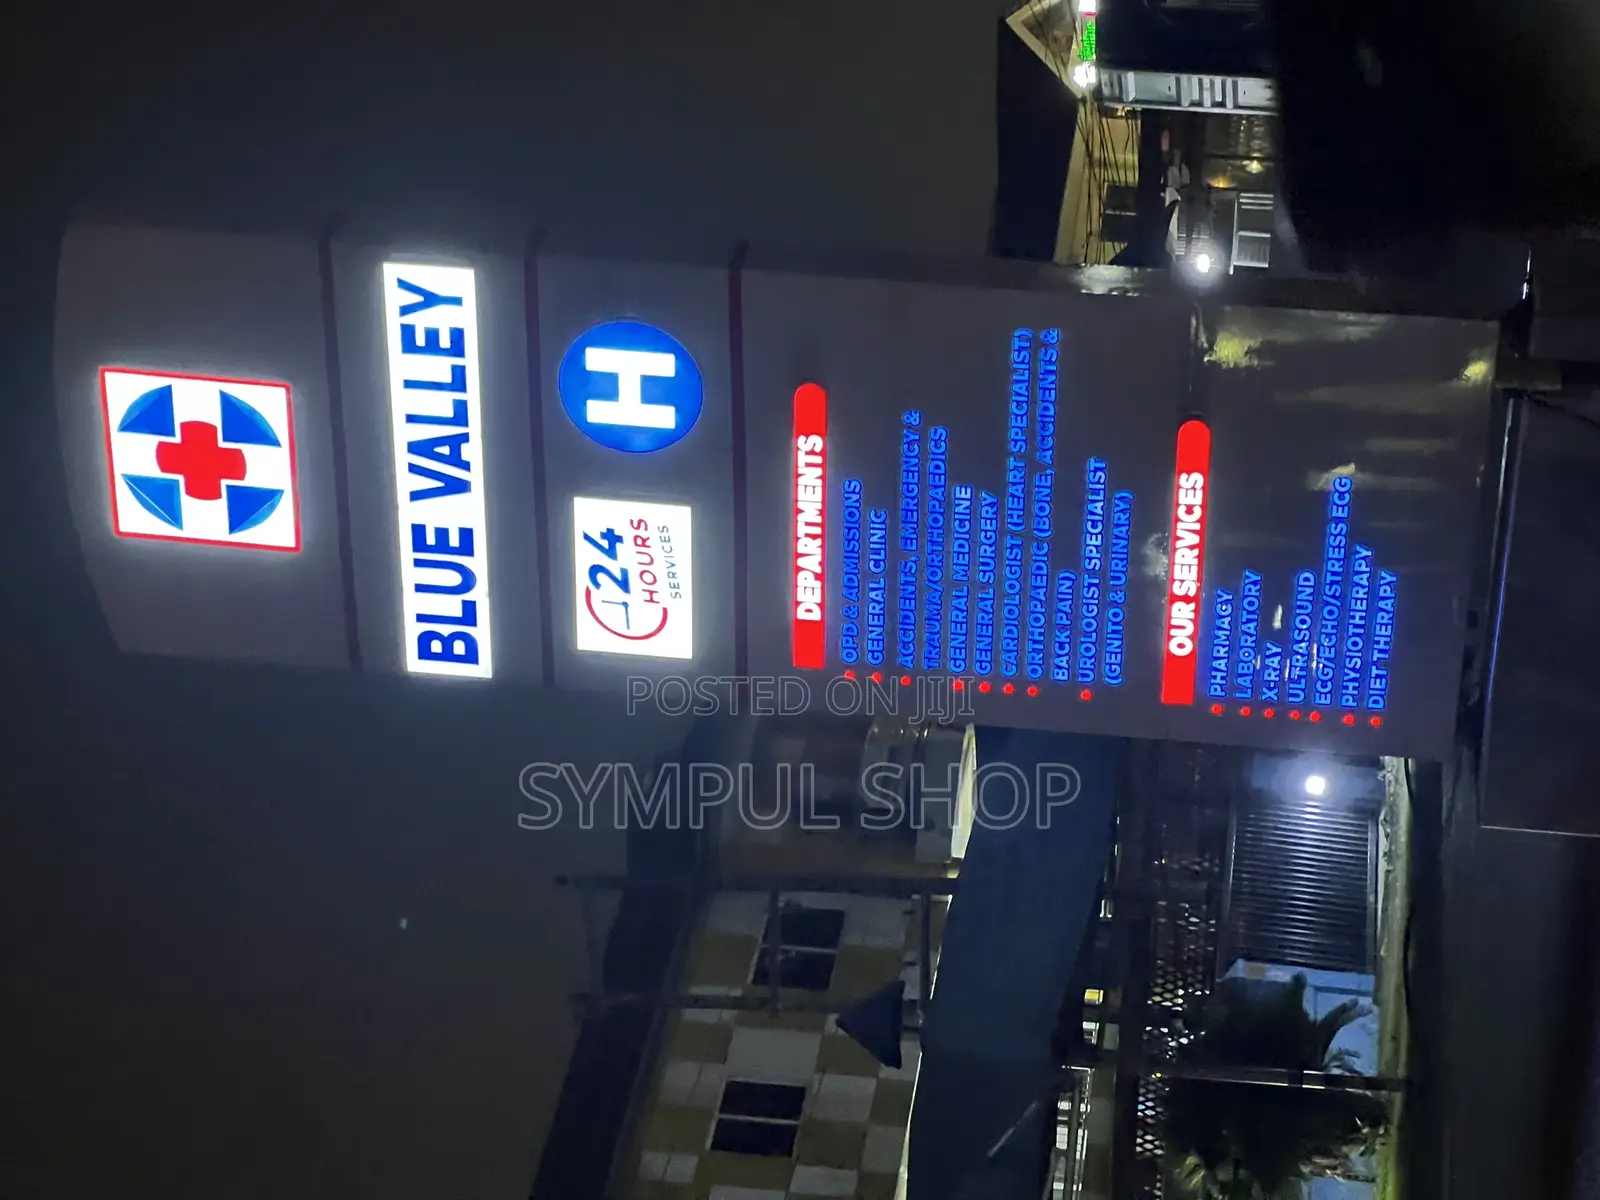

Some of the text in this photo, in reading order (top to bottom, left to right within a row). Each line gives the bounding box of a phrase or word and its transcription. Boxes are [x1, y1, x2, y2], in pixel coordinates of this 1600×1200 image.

[396, 277, 479, 665] BLUE VALLEY
[584, 348, 676, 430] H
[583, 528, 629, 595] 24
[630, 518, 659, 604] HOURS
[658, 525, 681, 600] SERVICES
[797, 435, 823, 621] DEPARTMENTS
[842, 479, 861, 663] OPD & ADMISSIONS
[868, 509, 887, 665] GENERAL CLINIC
[899, 410, 920, 668] ACCIDENTS, EMERGENCY &
[925, 427, 947, 670] TRAUMA/ORTHOPAEDICS
[951, 485, 972, 672] GENERAL MEDICINE
[976, 492, 998, 675] GENERAL SURGERY
[1002, 328, 1033, 677] CARDIOLOGIST (HEART SPECIALIST)
[1027, 328, 1059, 680] ORTHOPAEDIC (BONE, ACCIDENTS &
[1079, 457, 1106, 683] UROLOGIST SPECIALIST
[1104, 491, 1133, 685] (GENITO & URINARY)
[1170, 472, 1203, 656] OUR SERVICES
[1314, 477, 1352, 705] ECG/ECHO/STRESS ECG
[1053, 570, 1075, 681] BACK PAIN)
[1210, 589, 1233, 697] PHARMACY
[1236, 569, 1262, 699] LABORATORY
[1262, 642, 1282, 701] X-RAY
[1289, 571, 1315, 704] ULTRASOUND
[1341, 544, 1373, 708] PHYSIOTHERAPY
[1368, 570, 1397, 709] DIET THERAPY
